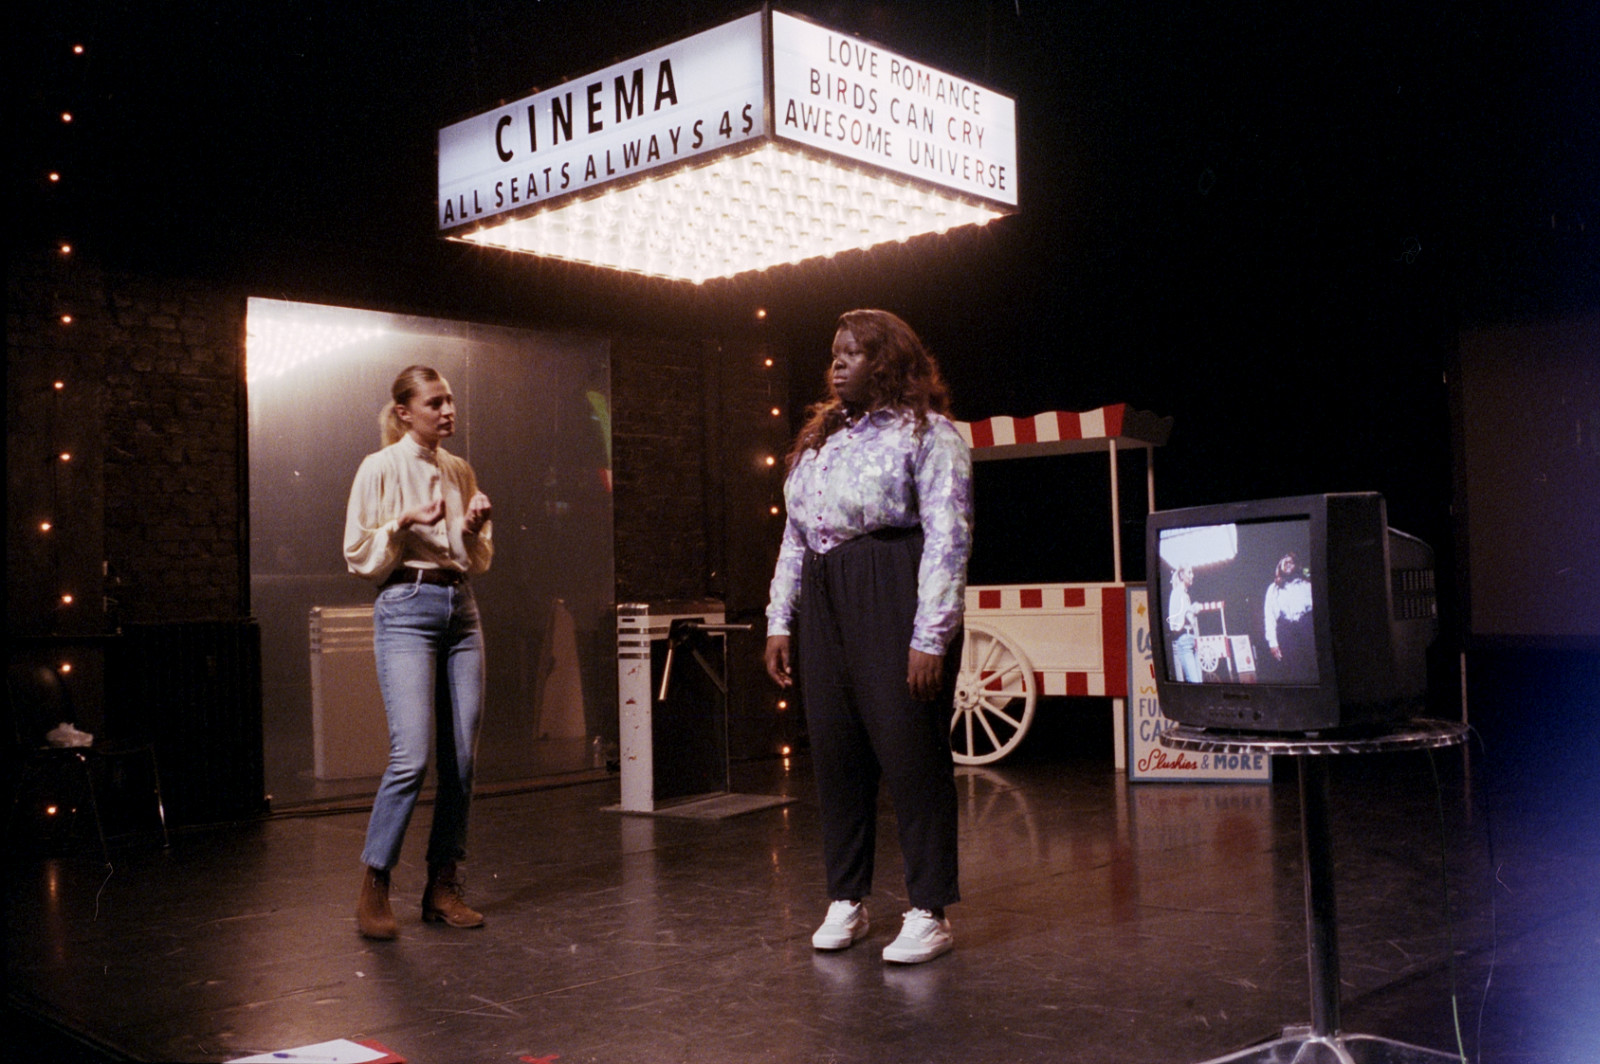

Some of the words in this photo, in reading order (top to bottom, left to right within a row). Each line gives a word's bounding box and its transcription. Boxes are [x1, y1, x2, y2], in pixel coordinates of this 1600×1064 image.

[494, 58, 678, 162] CINEMA
[810, 67, 878, 114] BIRDS
[890, 97, 934, 134] CAN
[947, 116, 985, 149] CRY
[828, 35, 878, 78] LOVE
[891, 58, 981, 115] ROMANCE
[443, 189, 483, 224] ALL
[495, 162, 570, 208] SEATS
[584, 119, 704, 181] ALWAYS
[784, 98, 892, 157] AWESOME
[909, 137, 1006, 190] UNIVERSE
[1138, 748, 1198, 772] Slushies
[1200, 754, 1209, 770] &
[1213, 754, 1263, 770] MORE
